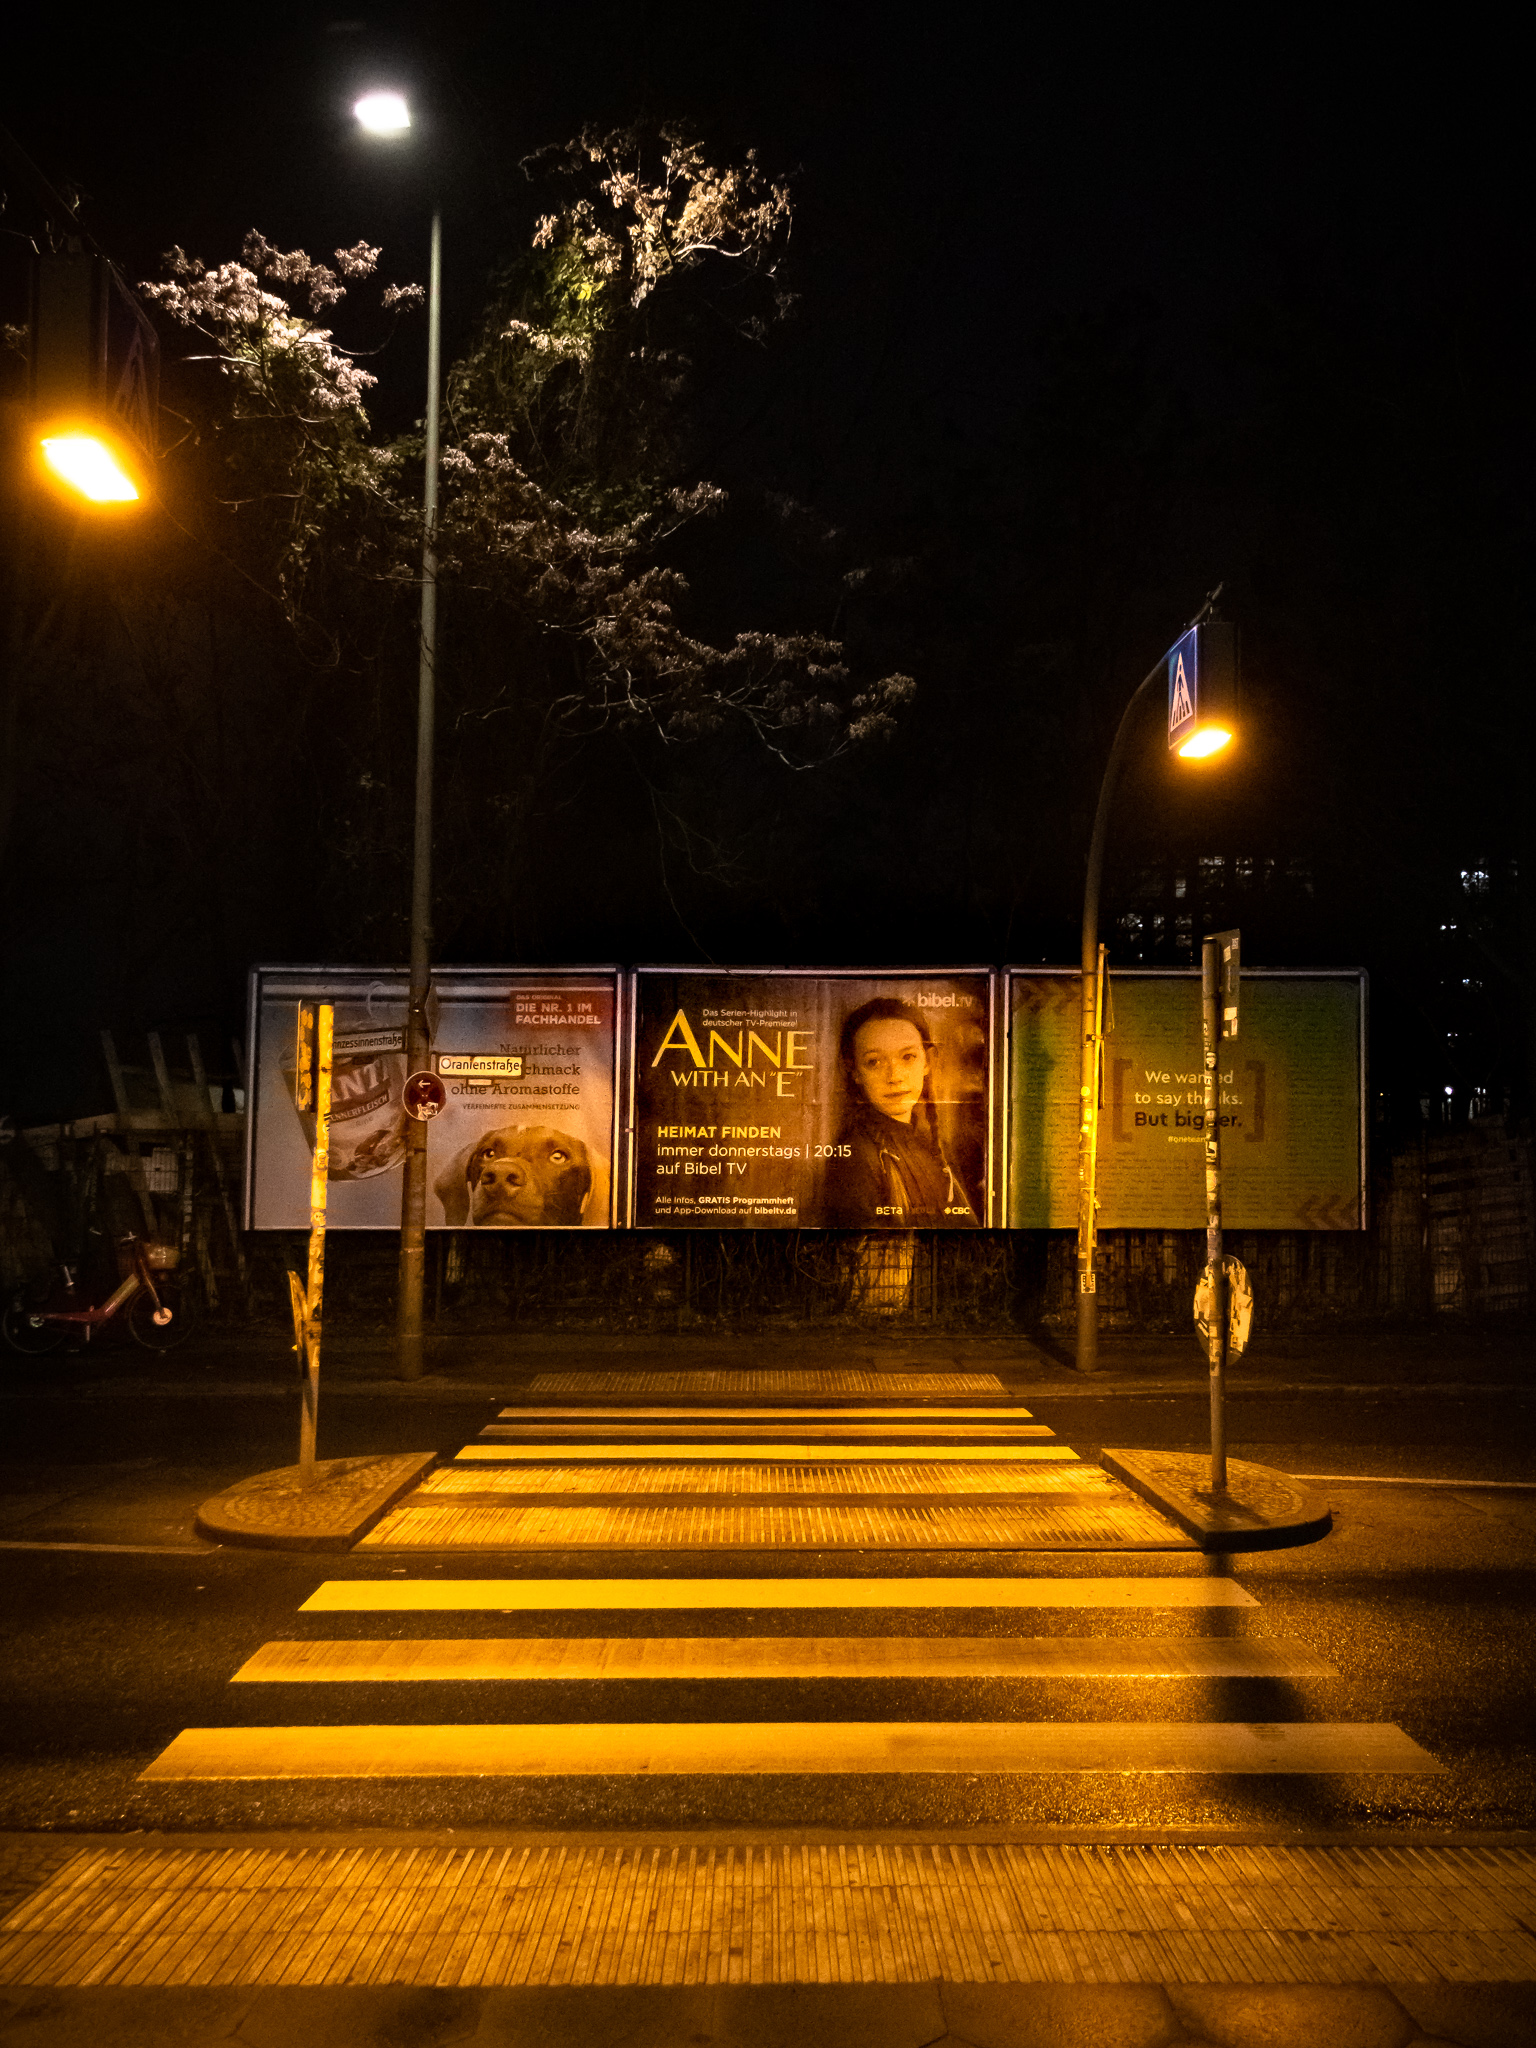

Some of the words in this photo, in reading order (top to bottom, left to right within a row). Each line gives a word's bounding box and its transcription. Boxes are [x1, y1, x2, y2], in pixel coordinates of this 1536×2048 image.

[516, 1003, 536, 1012] DIE
[541, 1003, 562, 1012] NR.
[567, 1003, 572, 1012] 1
[578, 1003, 591, 1012] IM
[721, 1009, 787, 1018] Serien-Highlight
[516, 1015, 601, 1024] FACHHANDEL
[332, 1033, 402, 1049] rinzessinnenstraße
[652, 1009, 814, 1069] ANNE
[500, 1044, 581, 1056] Natürlicher
[441, 1058, 520, 1073] Oranienstraße
[525, 1064, 581, 1075] chmack
[671, 1070, 729, 1087] WITH
[734, 1071, 766, 1087] AN
[1145, 1070, 1170, 1083] We
[451, 1084, 487, 1094] ohne
[492, 1083, 580, 1095] Aromastoffe
[1135, 1092, 1151, 1104] to
[1157, 1094, 1182, 1106] say
[1135, 1112, 1168, 1127] But
[1175, 1110, 1242, 1130] biger.
[658, 1126, 717, 1138] HEIMAT
[722, 1126, 781, 1138] FINDEN
[657, 1144, 704, 1156] immer
[709, 1144, 800, 1159] donnerstags
[814, 1145, 851, 1157] 20:15
[656, 1162, 680, 1174] auf
[685, 1163, 721, 1174] Bibel
[727, 1163, 747, 1174] TV
[656, 1196, 672, 1204] Alle
[733, 1197, 794, 1205] Programmheft
[674, 1207, 736, 1215] App-Download
[952, 1207, 970, 1215] CBC
